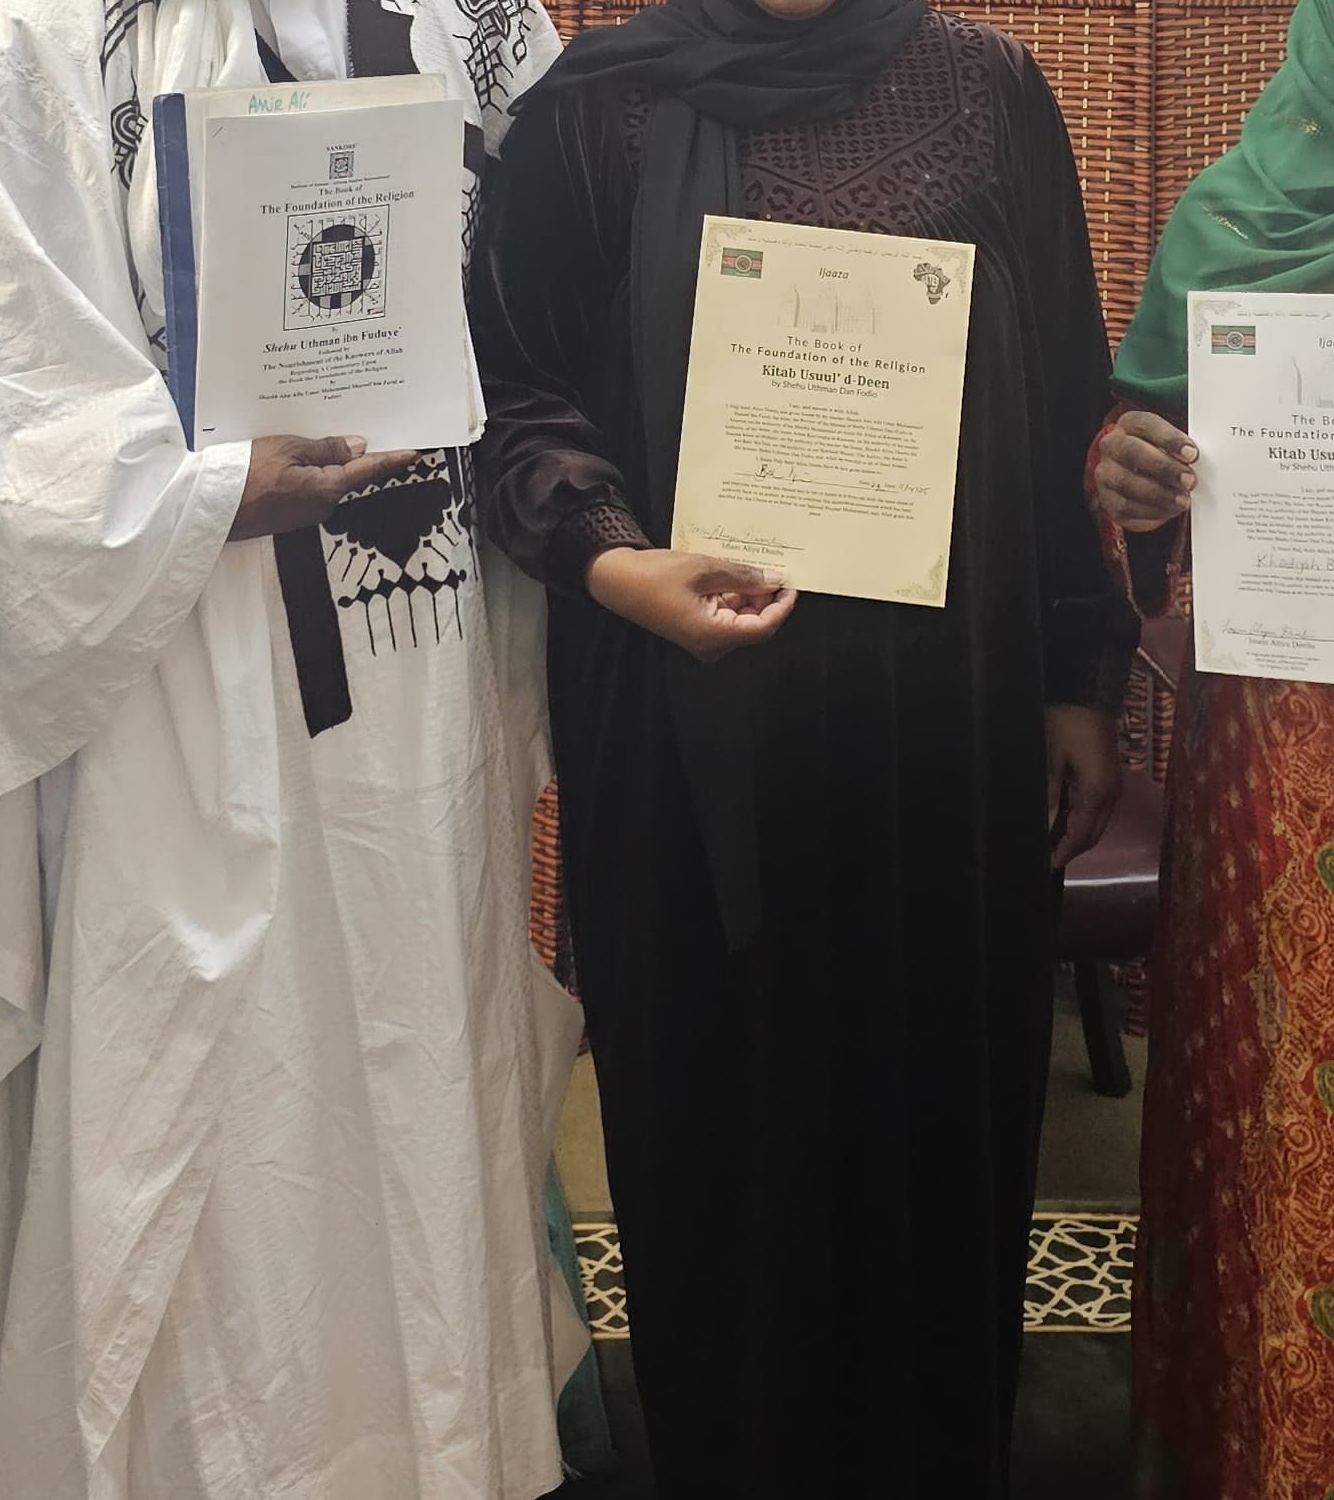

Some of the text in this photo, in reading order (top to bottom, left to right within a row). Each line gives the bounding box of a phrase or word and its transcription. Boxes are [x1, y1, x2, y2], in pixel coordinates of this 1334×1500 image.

[319, 188, 332, 196] The
[335, 186, 353, 194] Book
[260, 190, 415, 214] The Foundation of the Religion
[263, 342, 297, 354] Shehu
[300, 336, 340, 350] Uthman
[343, 334, 358, 344] ibn
[787, 336, 863, 353] The Book of
[731, 344, 925, 374] The Foundation of the Religion
[762, 364, 796, 379] Kitab
[844, 373, 889, 390] d-Deen
[771, 380, 878, 398] by Shehu Uthman Dan Fodio
[1292, 414, 1315, 426] The
[1230, 426, 1255, 437] The
[1269, 447, 1306, 460] Kitab
[1279, 463, 1291, 472] by
[1292, 463, 1317, 472] Shehu
